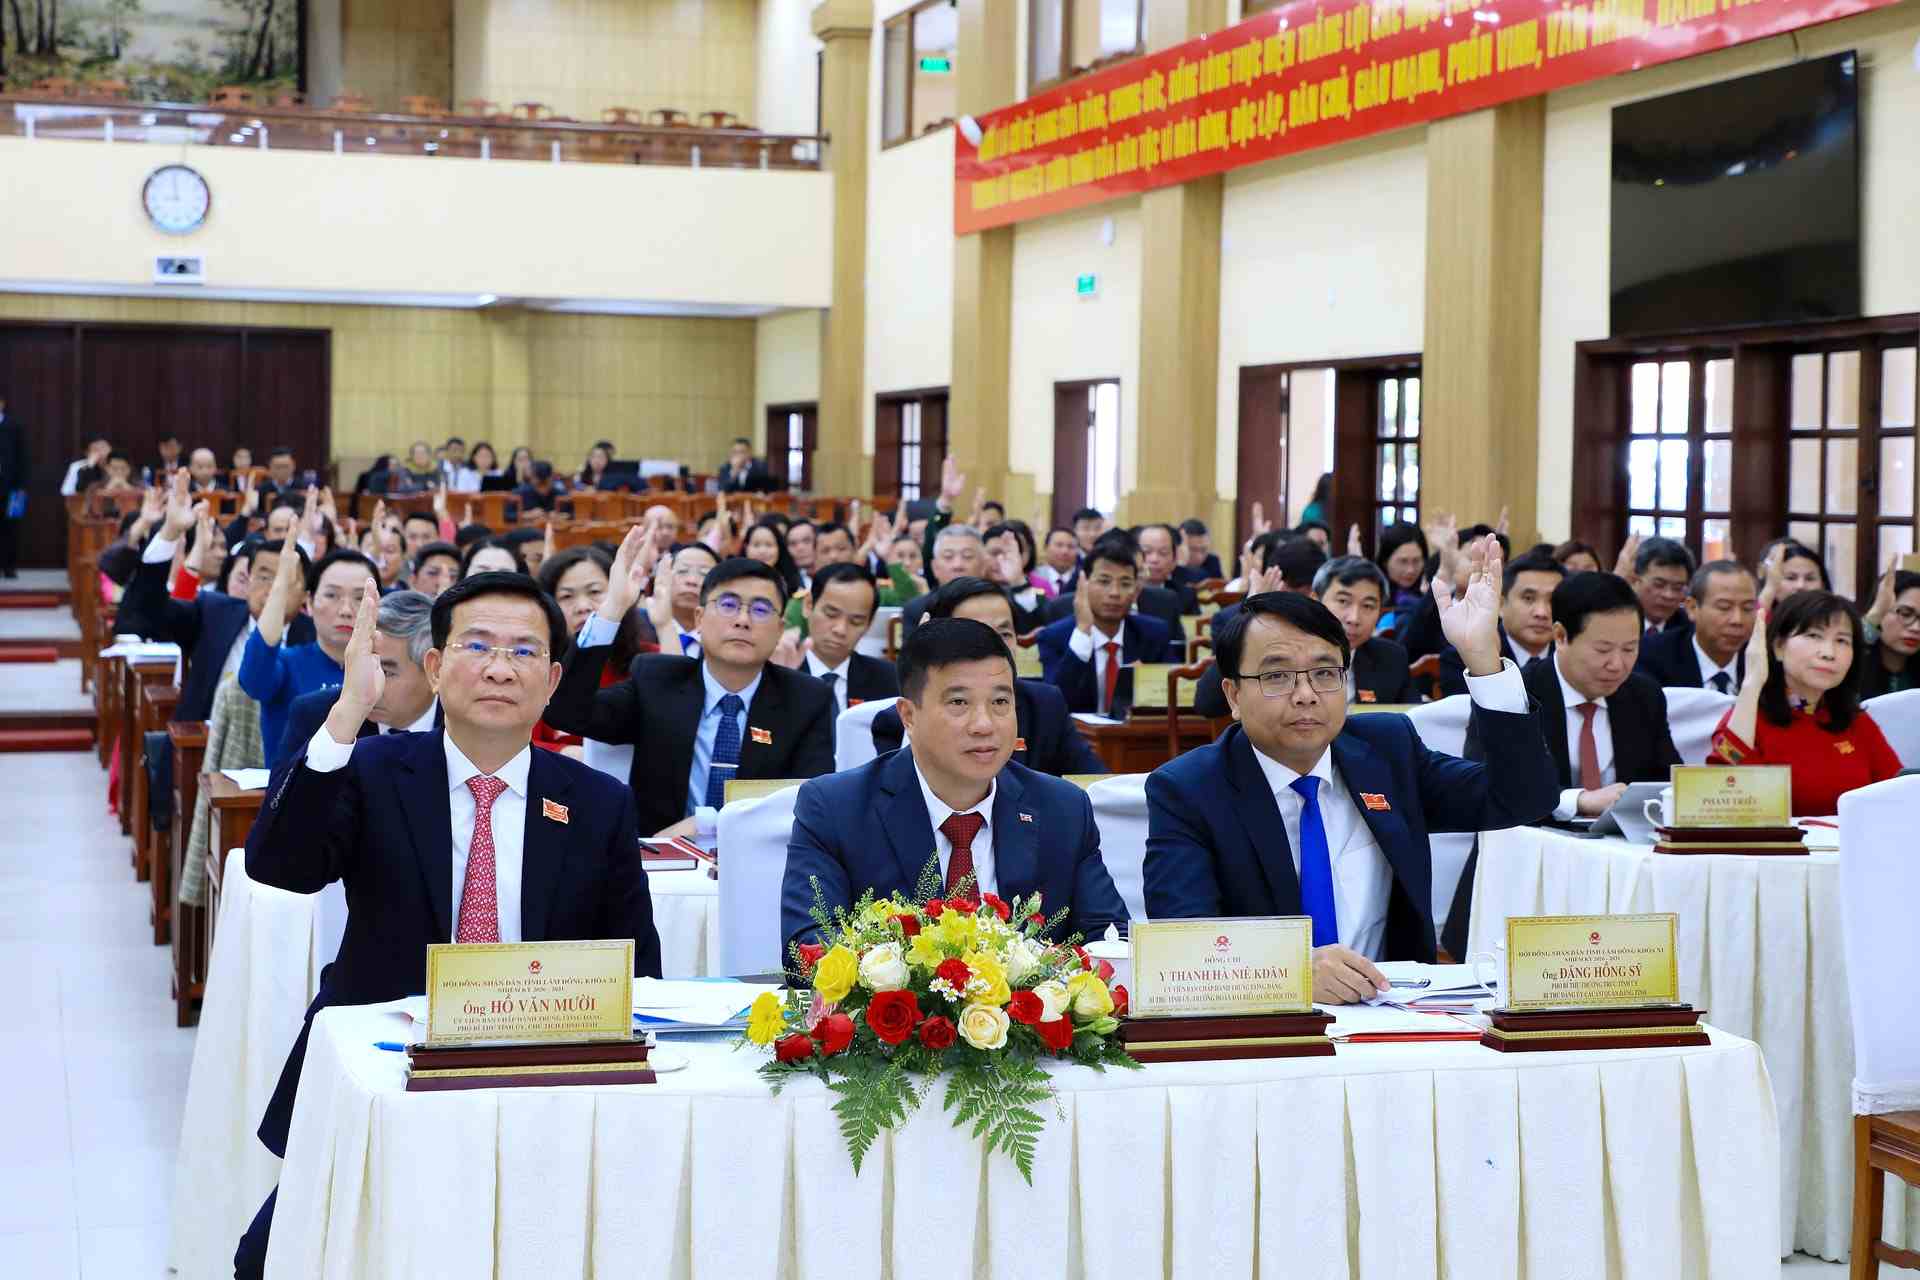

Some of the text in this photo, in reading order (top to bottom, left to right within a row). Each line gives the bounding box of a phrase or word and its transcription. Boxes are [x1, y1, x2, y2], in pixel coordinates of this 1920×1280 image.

[1159, 970, 1167, 981] Y
[1168, 970, 1209, 981] THANH
[1560, 965, 1591, 981] ĐẶNG
[1594, 961, 1626, 978] HỒNG
[463, 993, 596, 1016] Ông HỒ VĂN MƯỜI
